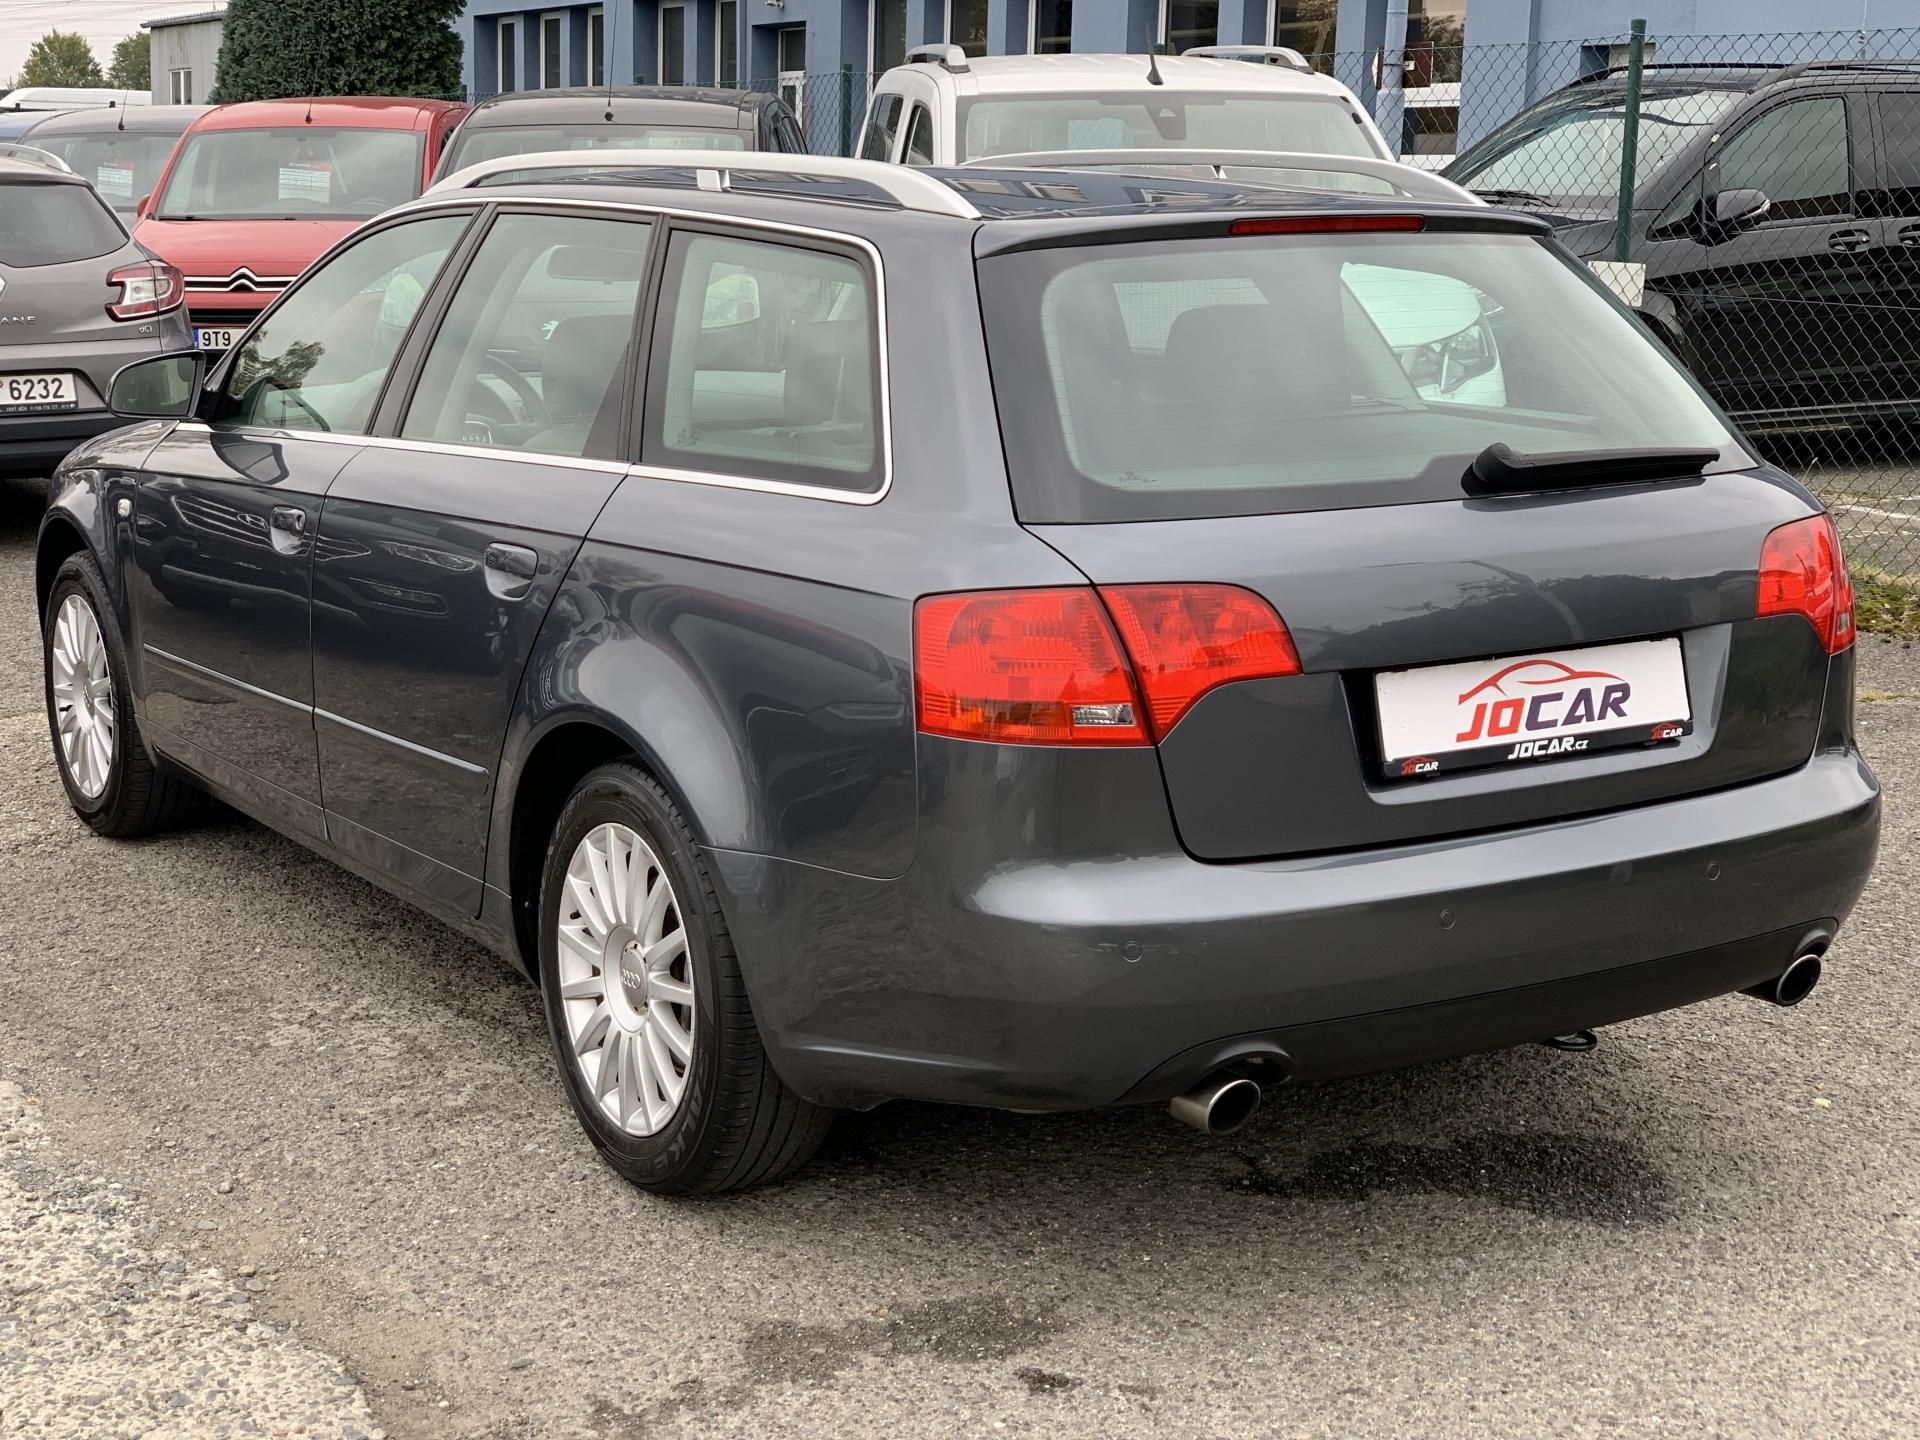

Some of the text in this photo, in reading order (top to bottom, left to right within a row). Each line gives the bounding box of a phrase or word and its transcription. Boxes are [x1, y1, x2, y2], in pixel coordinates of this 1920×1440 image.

[202, 331, 231, 347] 9T9
[9, 378, 65, 401] 6232
[1456, 682, 1631, 743] JOCAR
[1651, 728, 1683, 742] JOCAR
[1508, 737, 1589, 760] JOCAR.cz
[1401, 761, 1439, 776] JOCAR
